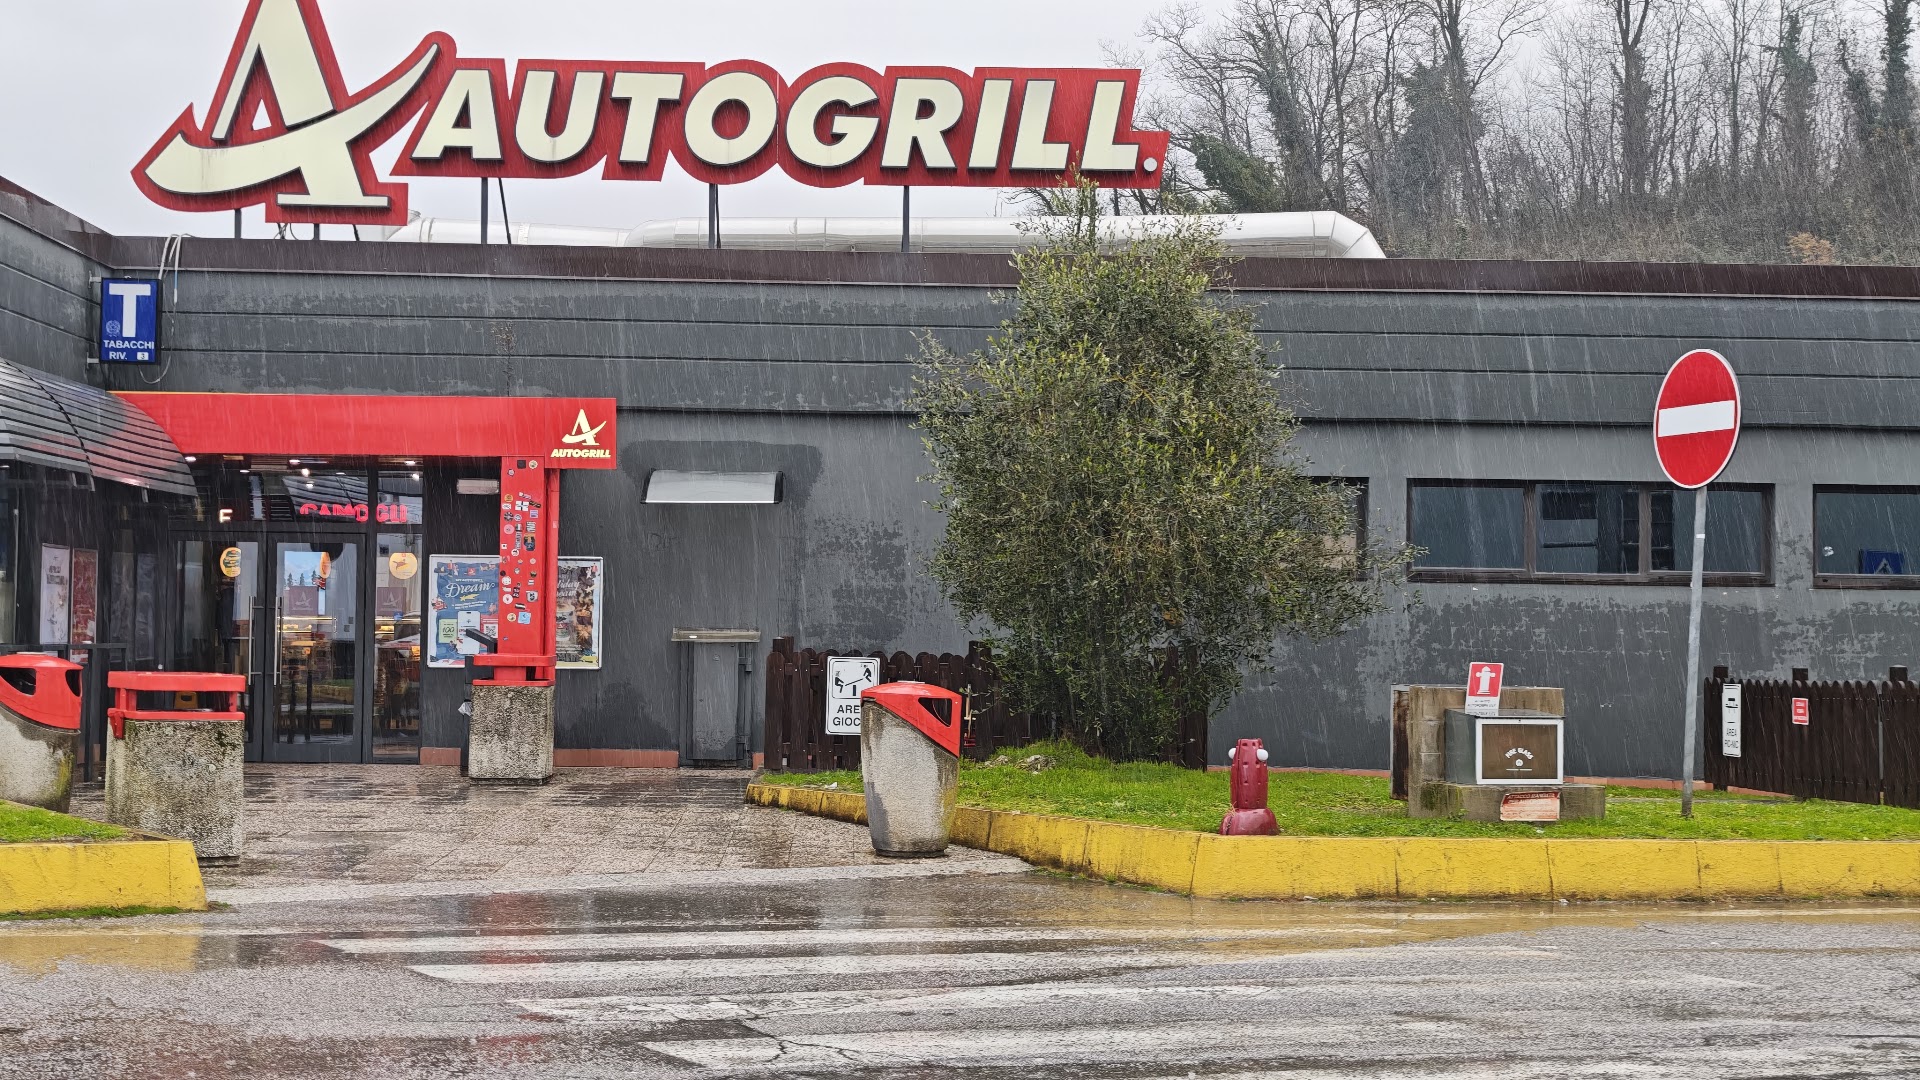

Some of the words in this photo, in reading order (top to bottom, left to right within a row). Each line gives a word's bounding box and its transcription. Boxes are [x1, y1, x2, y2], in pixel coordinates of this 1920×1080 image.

[108, 283, 151, 338] T
[103, 340, 155, 350] TABACCHI
[109, 351, 128, 360] RIV.
[550, 449, 611, 458] AUTOGRILL
[445, 582, 495, 598] Dream
[836, 704, 861, 714] ARE
[833, 716, 861, 727] GIOC
